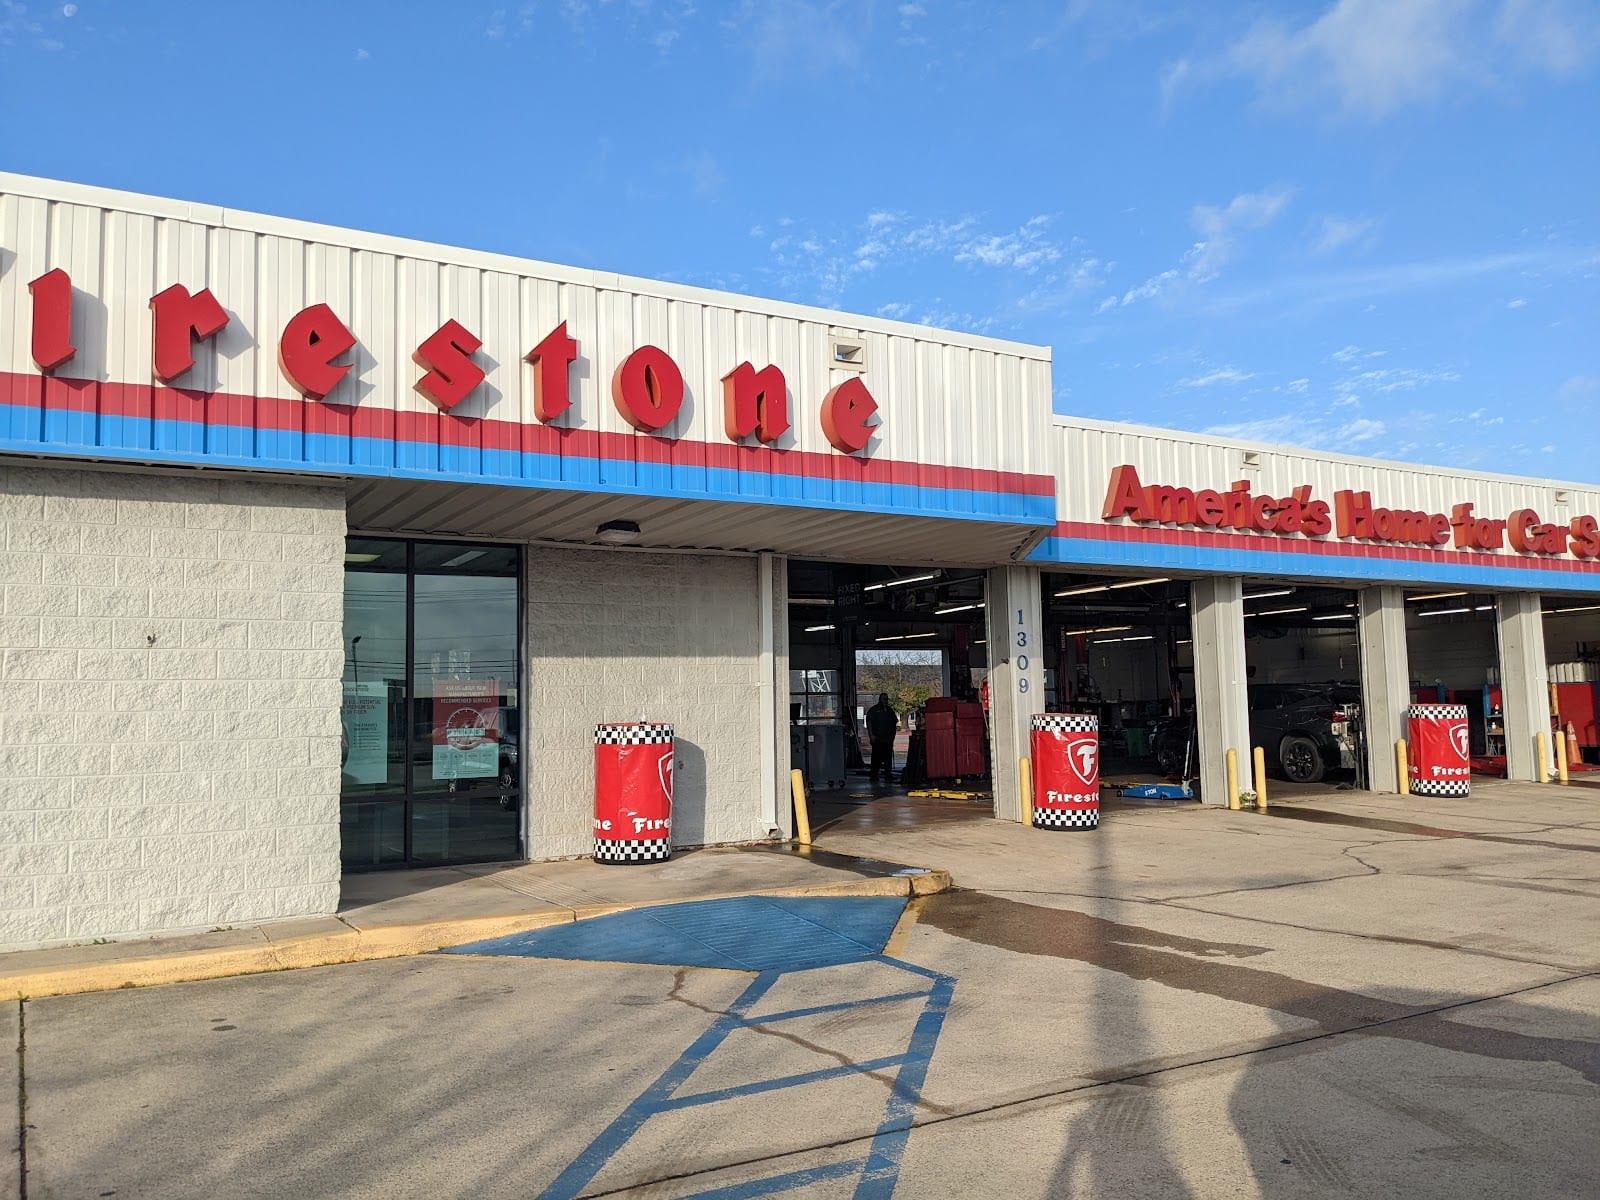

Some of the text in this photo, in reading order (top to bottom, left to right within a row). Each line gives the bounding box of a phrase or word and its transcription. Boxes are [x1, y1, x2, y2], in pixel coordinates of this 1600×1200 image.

[28, 267, 879, 455] irestone
[1102, 464, 1332, 537] America's
[1334, 489, 1450, 546] Home
[1450, 502, 1506, 550] for
